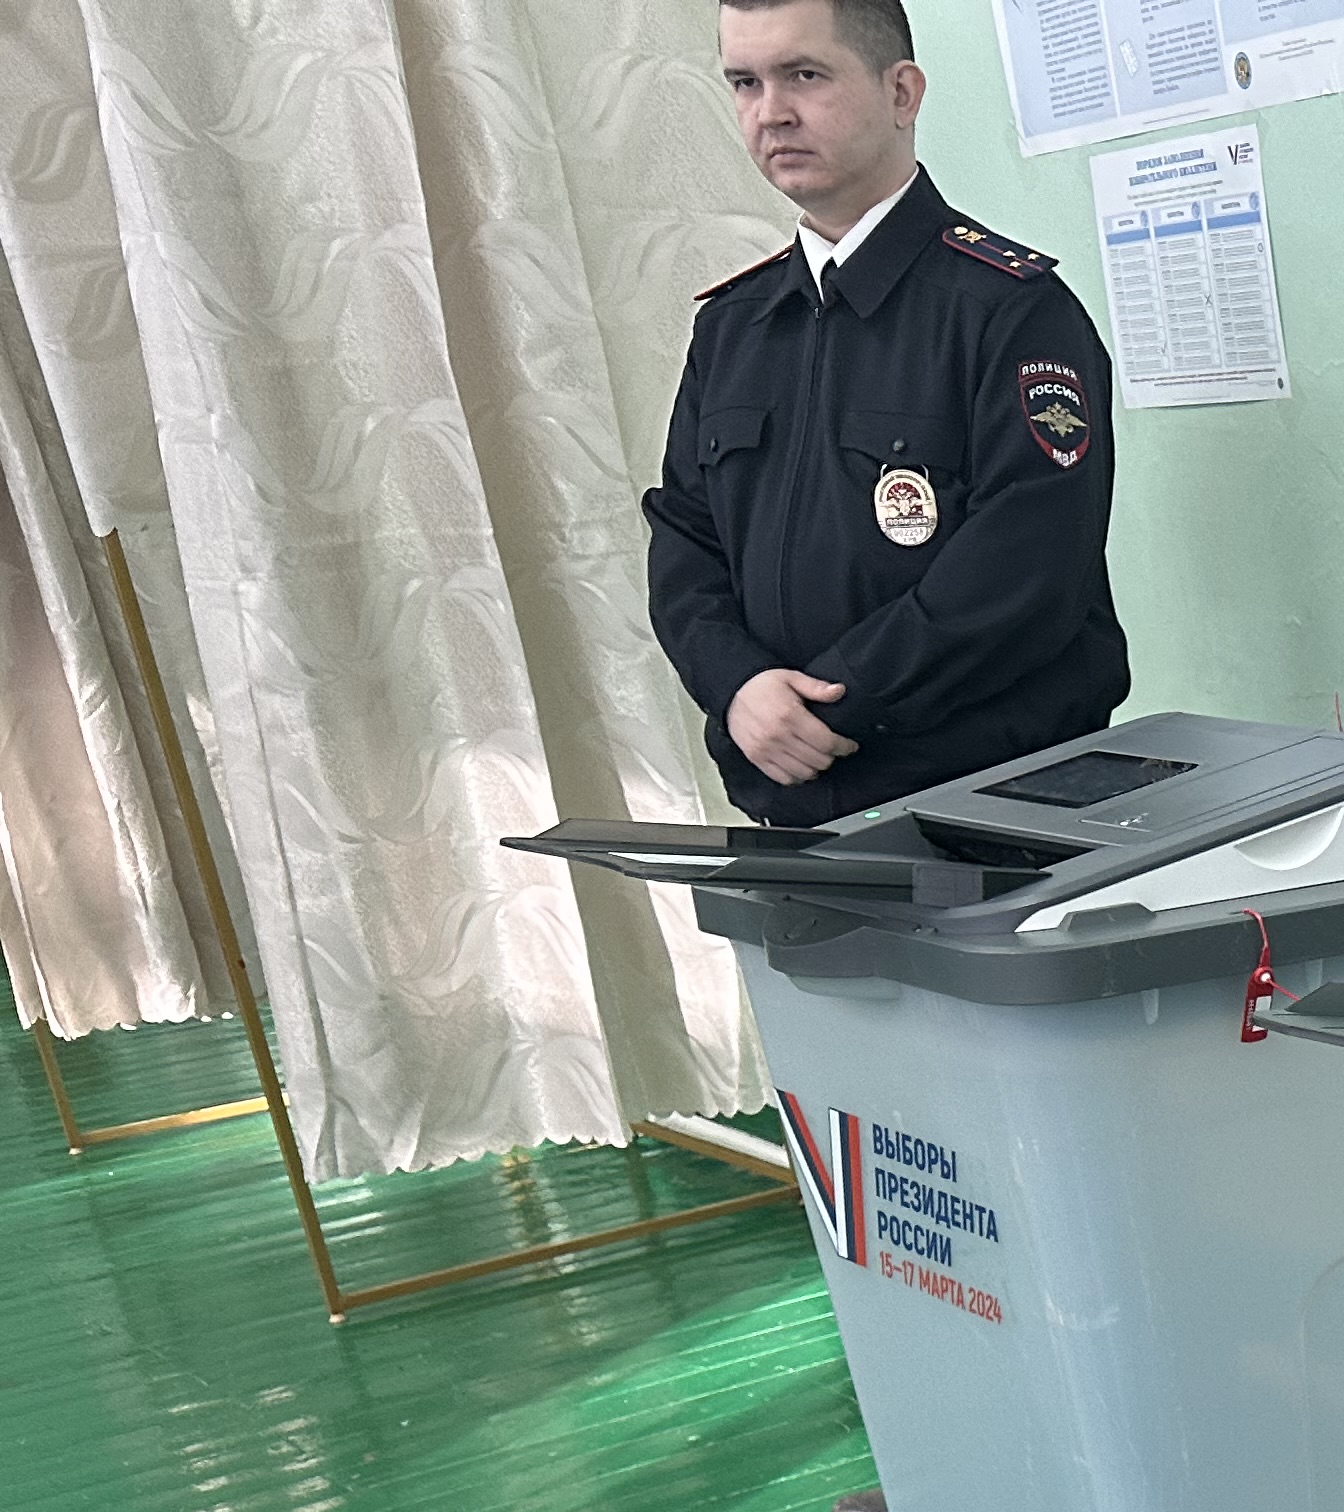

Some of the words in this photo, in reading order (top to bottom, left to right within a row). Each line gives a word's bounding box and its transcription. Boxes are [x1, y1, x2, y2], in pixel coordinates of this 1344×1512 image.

[1021, 362, 1078, 382] ПОЛИЦИЯ
[1028, 383, 1081, 407] РОССИЯ
[873, 1123, 957, 1182] ВЫБОРЫ
[875, 1167, 999, 1243] ПРЕЗИДЕНТА
[877, 1211, 951, 1266] РОССИИ
[919, 1266, 965, 1310] МАРТА
[968, 1288, 1002, 1324] 2024
